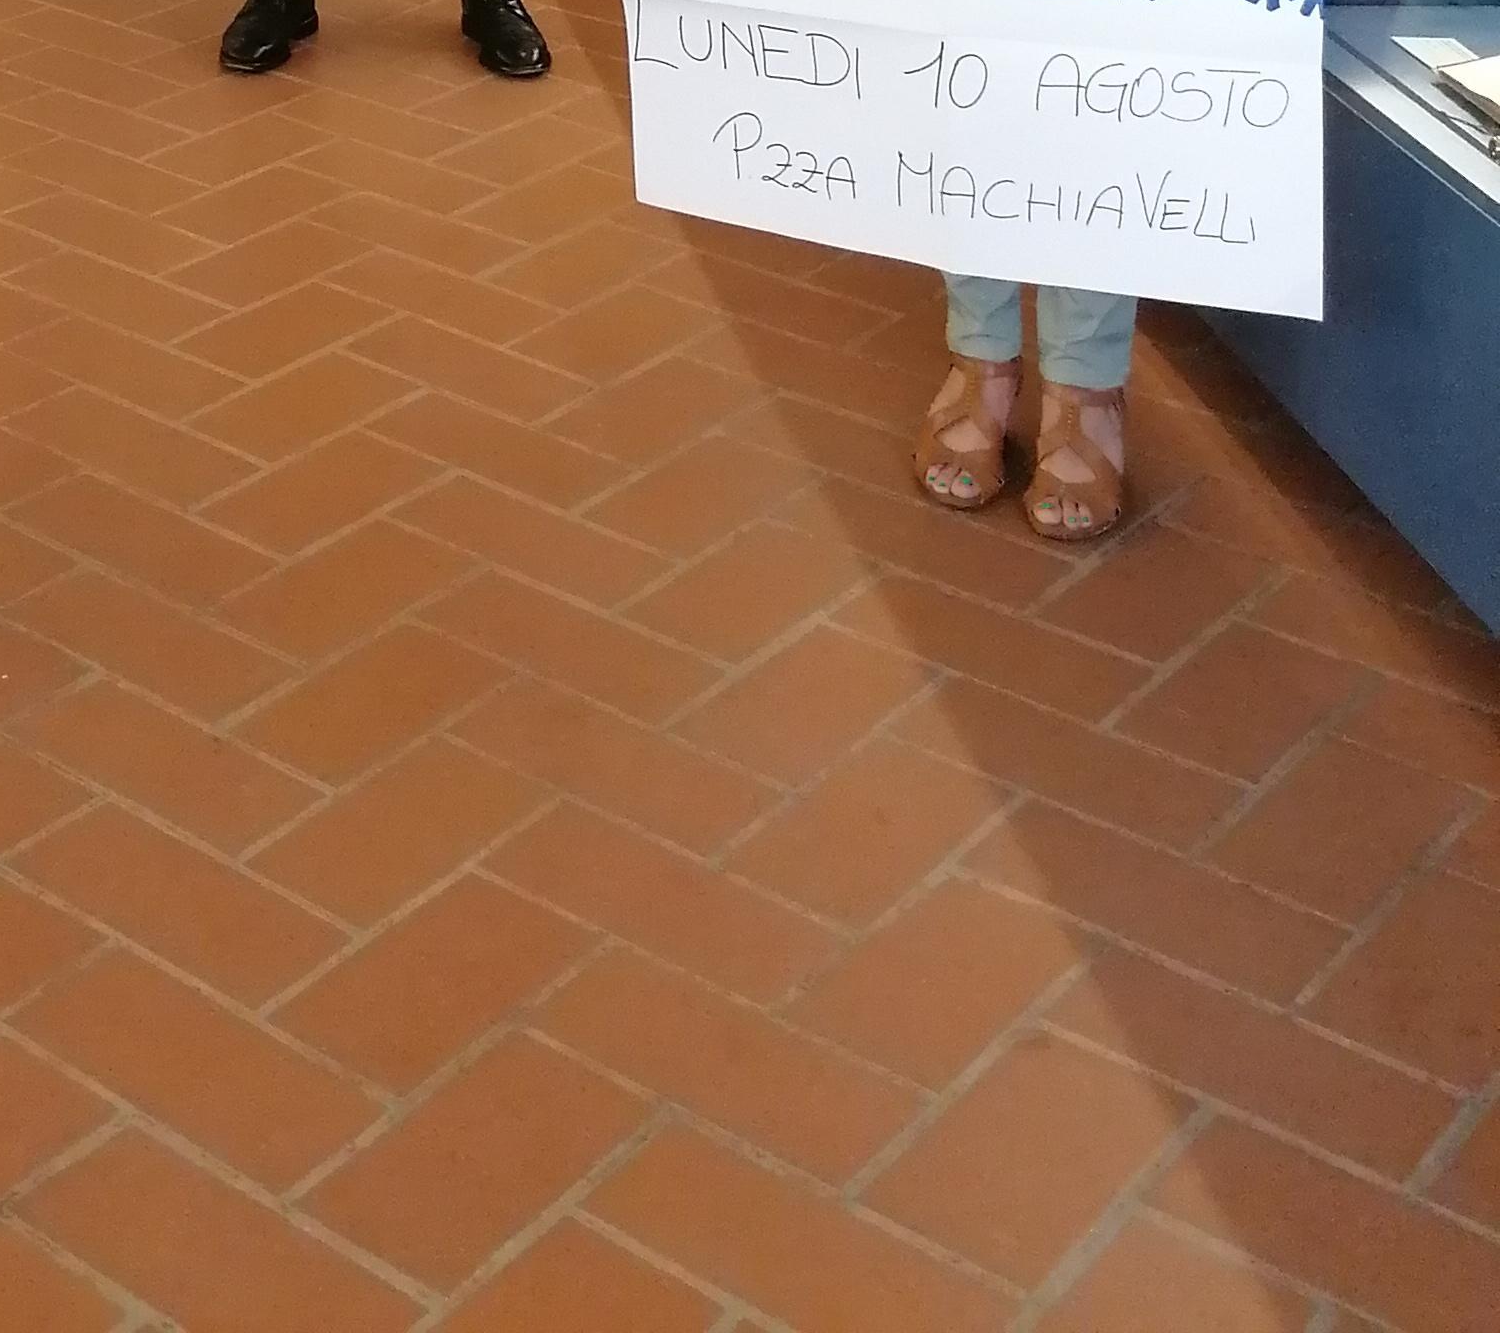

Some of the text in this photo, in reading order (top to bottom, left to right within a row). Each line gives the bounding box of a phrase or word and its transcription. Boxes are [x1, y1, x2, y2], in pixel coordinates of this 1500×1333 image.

[903, 41, 989, 112] 10
[1035, 52, 1291, 130] AGOSTO
[896, 151, 1258, 245] MACHIAVELLI
